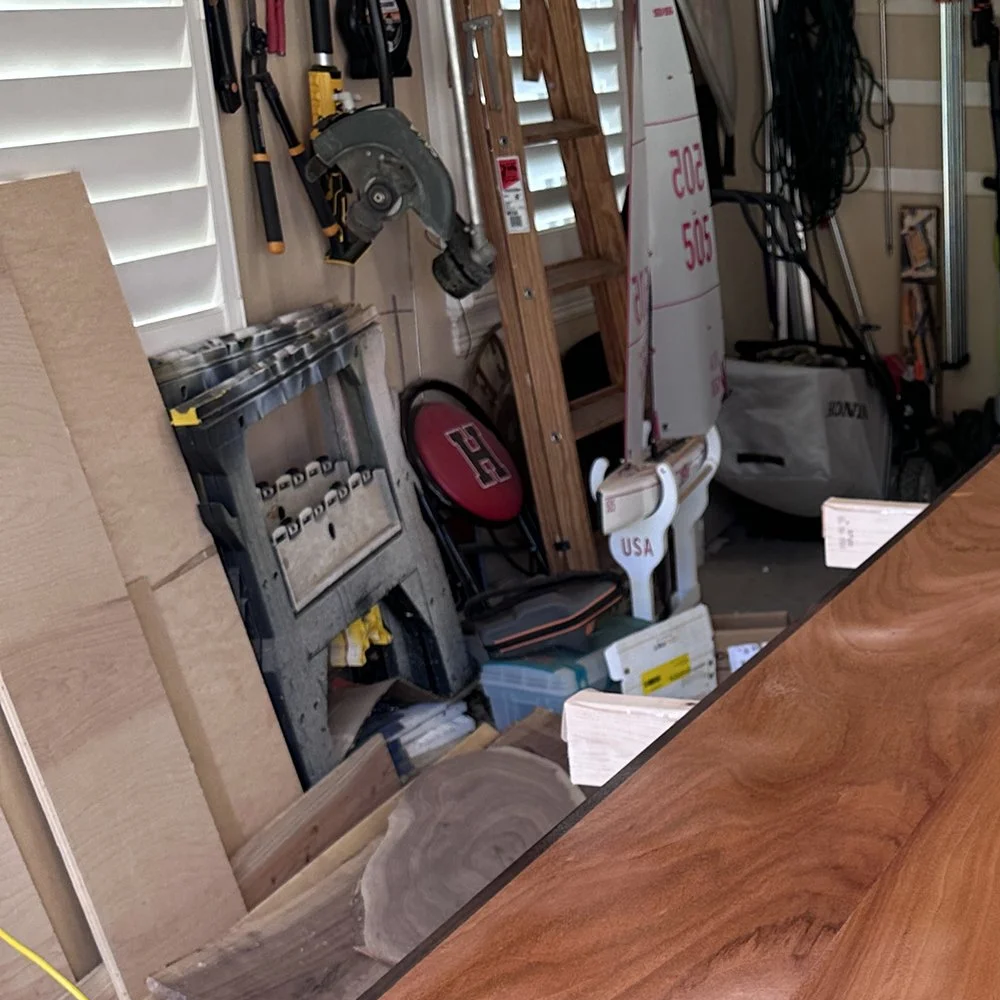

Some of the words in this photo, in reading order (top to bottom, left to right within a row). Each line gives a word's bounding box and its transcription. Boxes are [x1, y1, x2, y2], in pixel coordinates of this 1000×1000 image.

[681, 215, 713, 271] 505
[444, 423, 513, 490] H
[620, 536, 655, 557] USA
